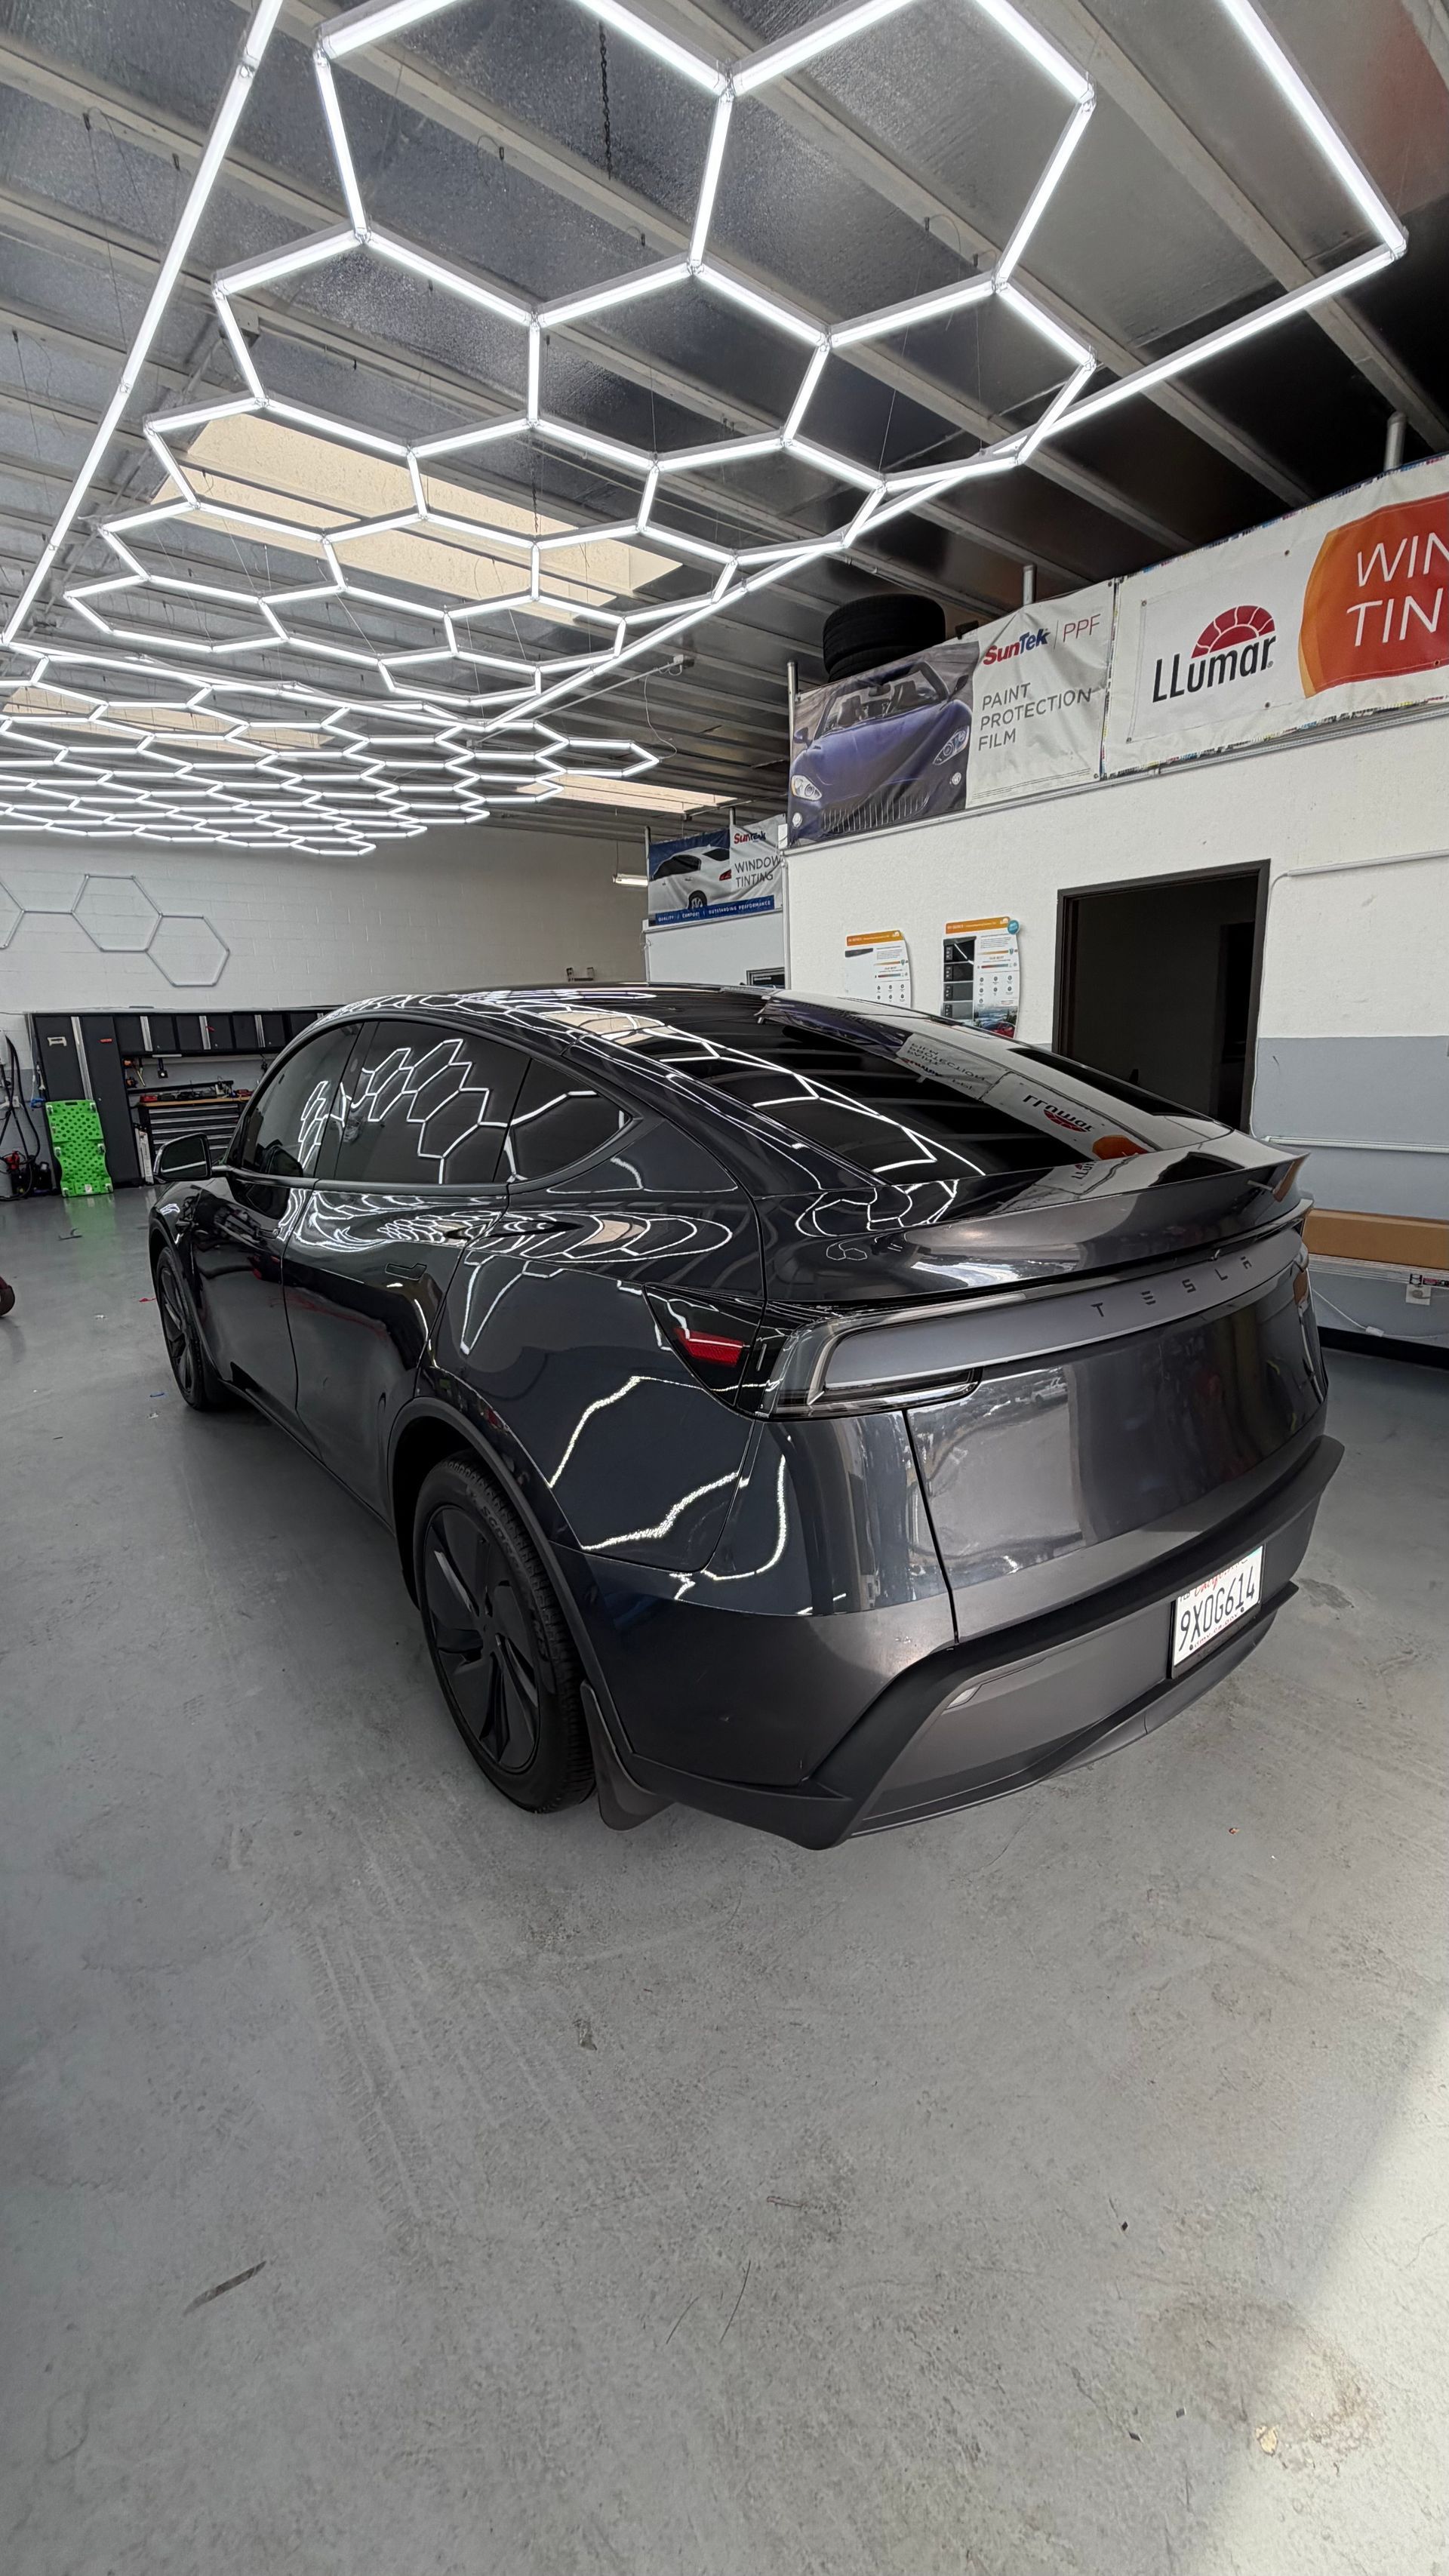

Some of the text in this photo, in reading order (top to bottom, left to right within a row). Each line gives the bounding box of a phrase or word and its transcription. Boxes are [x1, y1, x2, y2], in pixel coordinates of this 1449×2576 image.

[983, 614, 1101, 665] SunTek PPF
[1152, 636, 1276, 703] LLumar
[980, 688, 1091, 731] PROTECTION
[983, 682, 1030, 710] PAINT
[978, 728, 1016, 751] FILM
[734, 855, 783, 873] WINDOW
[736, 872, 773, 888] TINTING
[1091, 1256, 1252, 1317] TESLA
